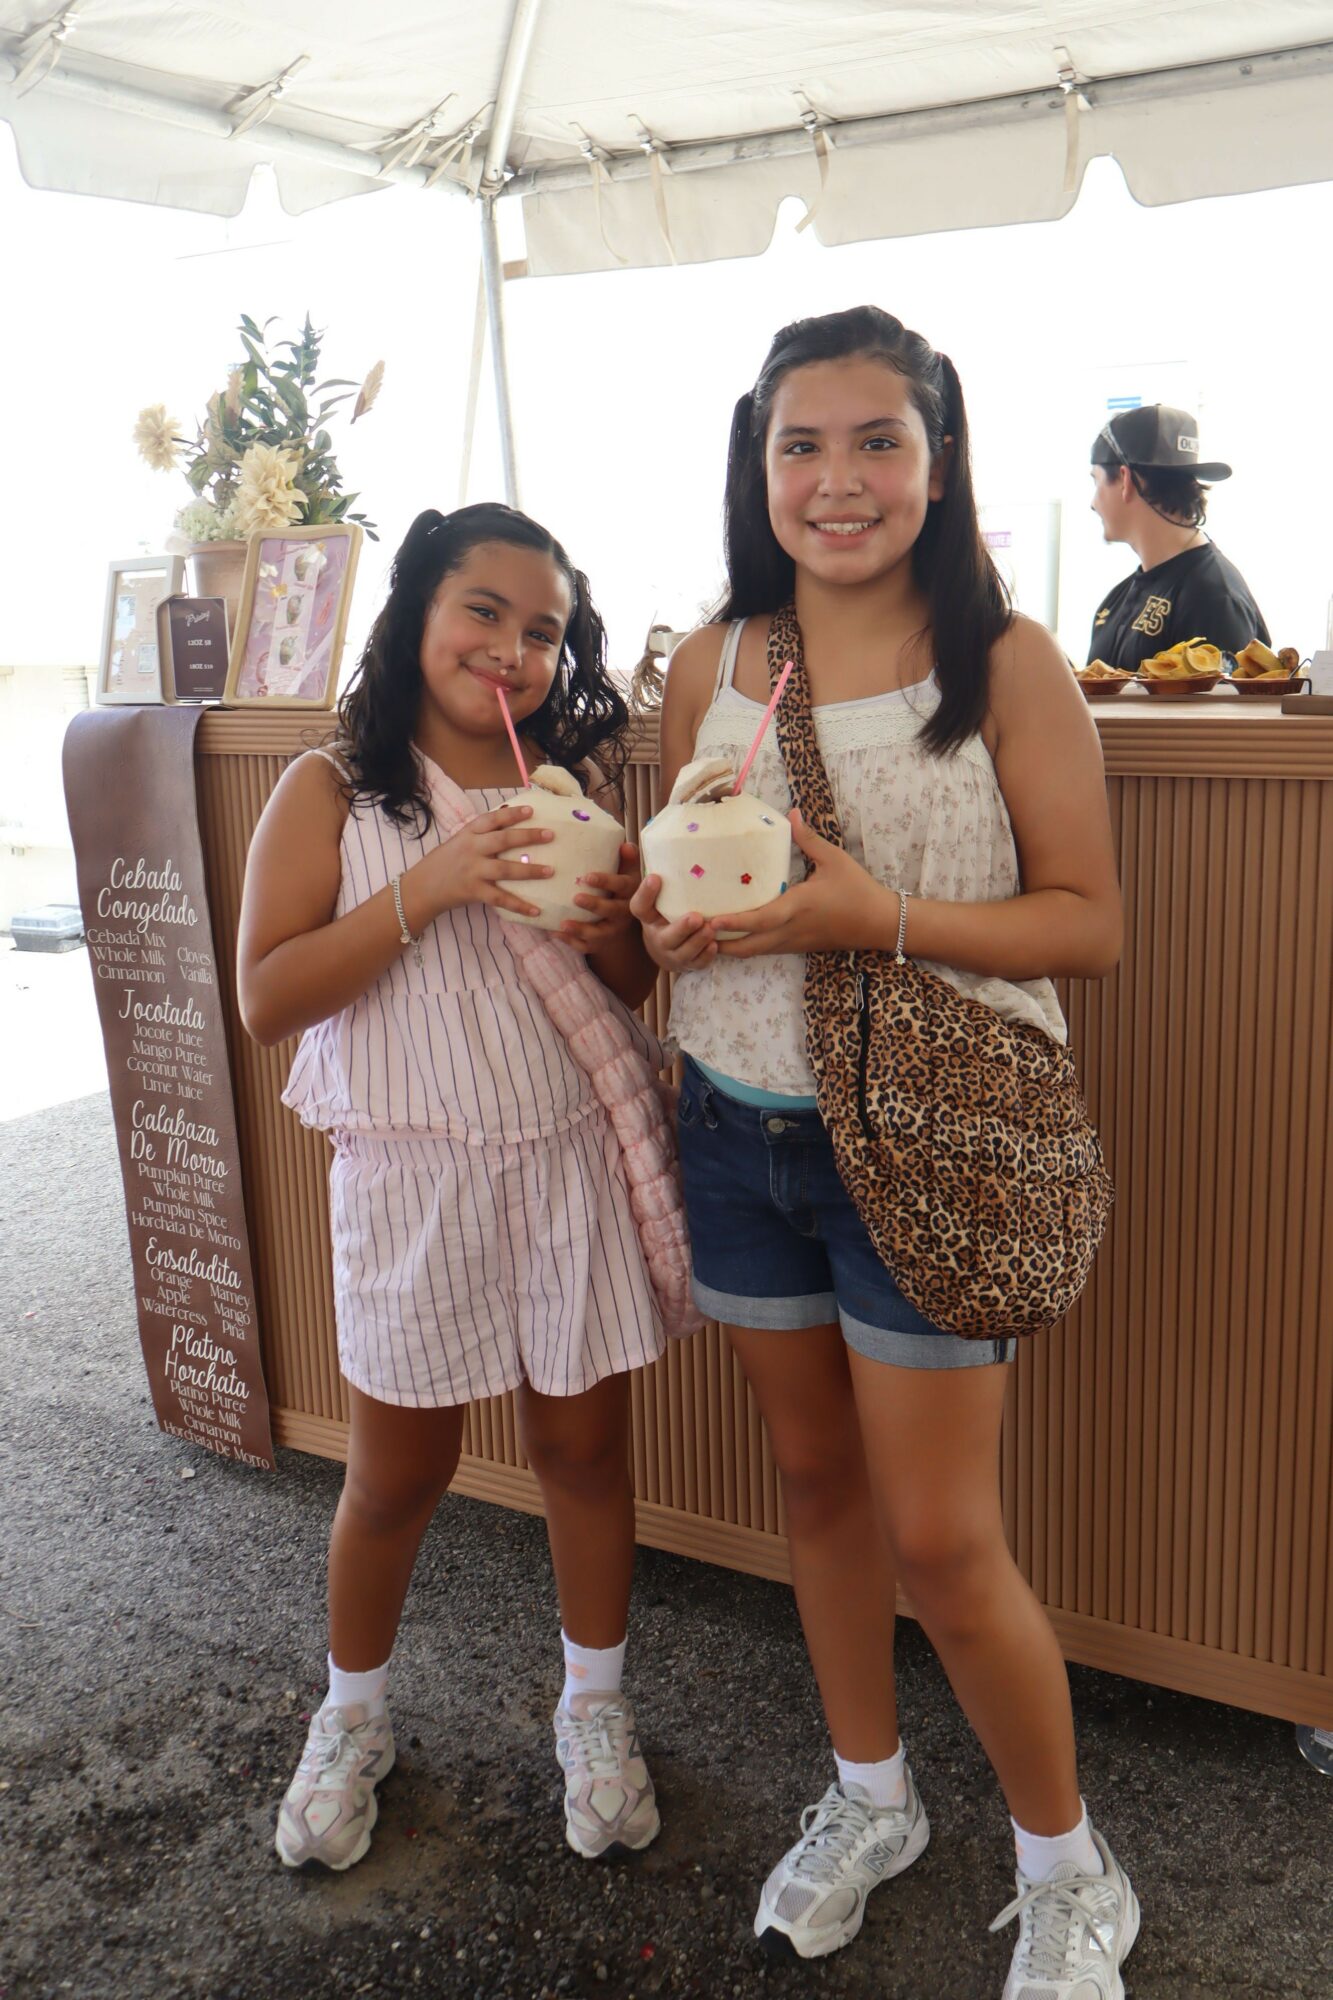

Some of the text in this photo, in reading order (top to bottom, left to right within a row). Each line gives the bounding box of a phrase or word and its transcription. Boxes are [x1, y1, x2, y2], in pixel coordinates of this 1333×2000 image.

[1131, 594, 1171, 638] ES
[110, 858, 182, 891] Cebada
[98, 888, 198, 933] Congelado
[87, 928, 167, 948] Cebada Mix
[92, 946, 166, 966] Whole Milk
[177, 947, 211, 966] Cloves
[98, 965, 165, 984] Cinnamon
[180, 966, 212, 984] Vanilla
[118, 989, 206, 1030] Jocotada
[134, 1023, 204, 1048] Jocote Juice
[132, 1040, 207, 1066] Mango Puree
[127, 1056, 214, 1086] Coconut Water
[142, 1076, 203, 1100] Lime Juice
[132, 1100, 219, 1146] Calabaza
[130, 1130, 230, 1178] De Morro
[138, 1162, 225, 1194] Pumpkin Puree
[152, 1182, 215, 1208] Whole Milk
[144, 1196, 228, 1230] Pumpkin Spice
[132, 1212, 241, 1250] Horchata De Morro
[146, 1236, 242, 1289] Ensaladita
[150, 1266, 192, 1292] Orange
[142, 1297, 208, 1326] Watercress
[157, 1286, 191, 1306] Apple
[210, 1283, 251, 1311] Mamey
[214, 1302, 250, 1326] Mango
[172, 1324, 238, 1366] Platino
[164, 1349, 250, 1399] Horchata
[170, 1380, 247, 1414] Platino Puree
[178, 1398, 242, 1430] Whole Milk
[184, 1414, 241, 1446] Cinnamon
[163, 1420, 270, 1470] Horchata De Morro
